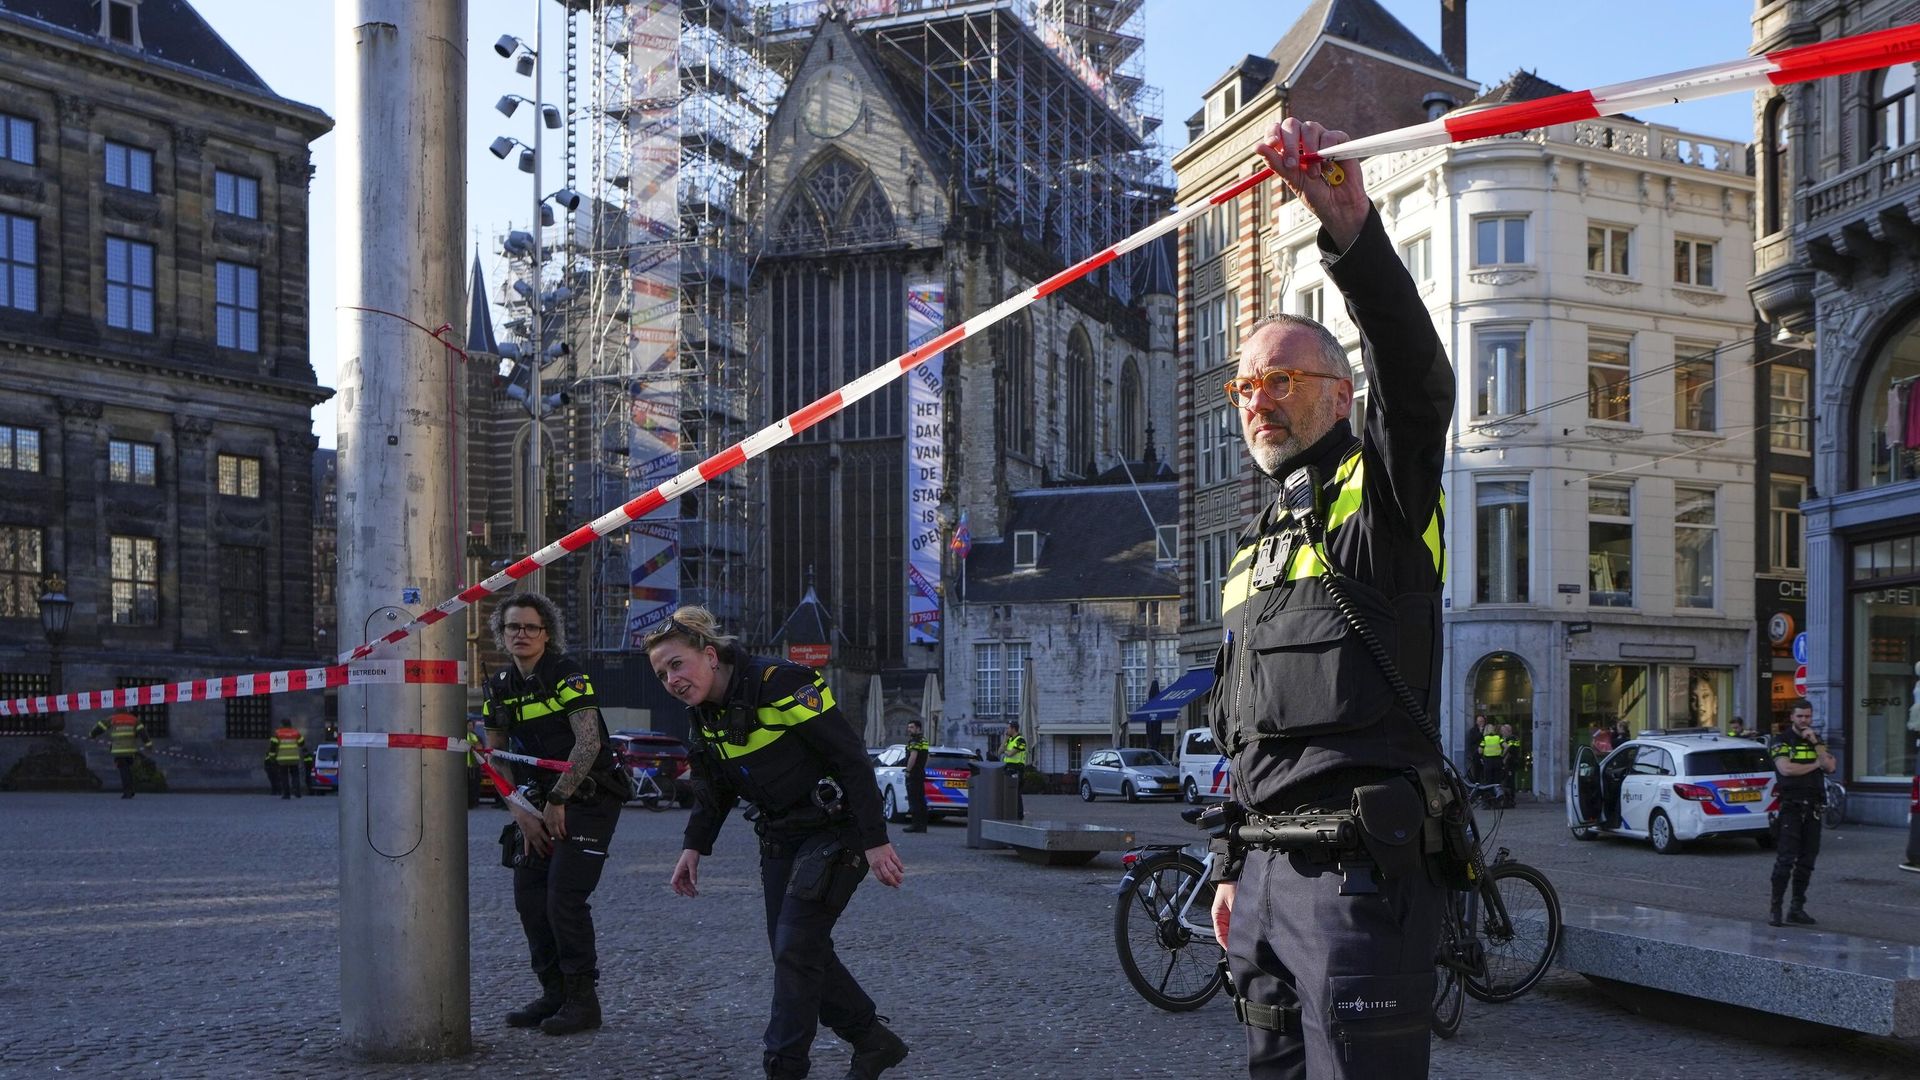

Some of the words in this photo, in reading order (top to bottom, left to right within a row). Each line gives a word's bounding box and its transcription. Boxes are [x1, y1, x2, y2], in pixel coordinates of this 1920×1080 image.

[913, 362, 943, 398] OERA
[917, 403, 939, 416] HET
[916, 424, 940, 438] DAK
[916, 445, 939, 459] VAN
[921, 467, 936, 480] DE
[913, 488, 943, 502] STAD
[923, 510, 934, 523] IS
[912, 528, 942, 551] OPEN
[1779, 581, 1807, 597] CH
[352, 668, 387, 676] BETREDEN
[1350, 996, 1389, 1011] POLITIE
